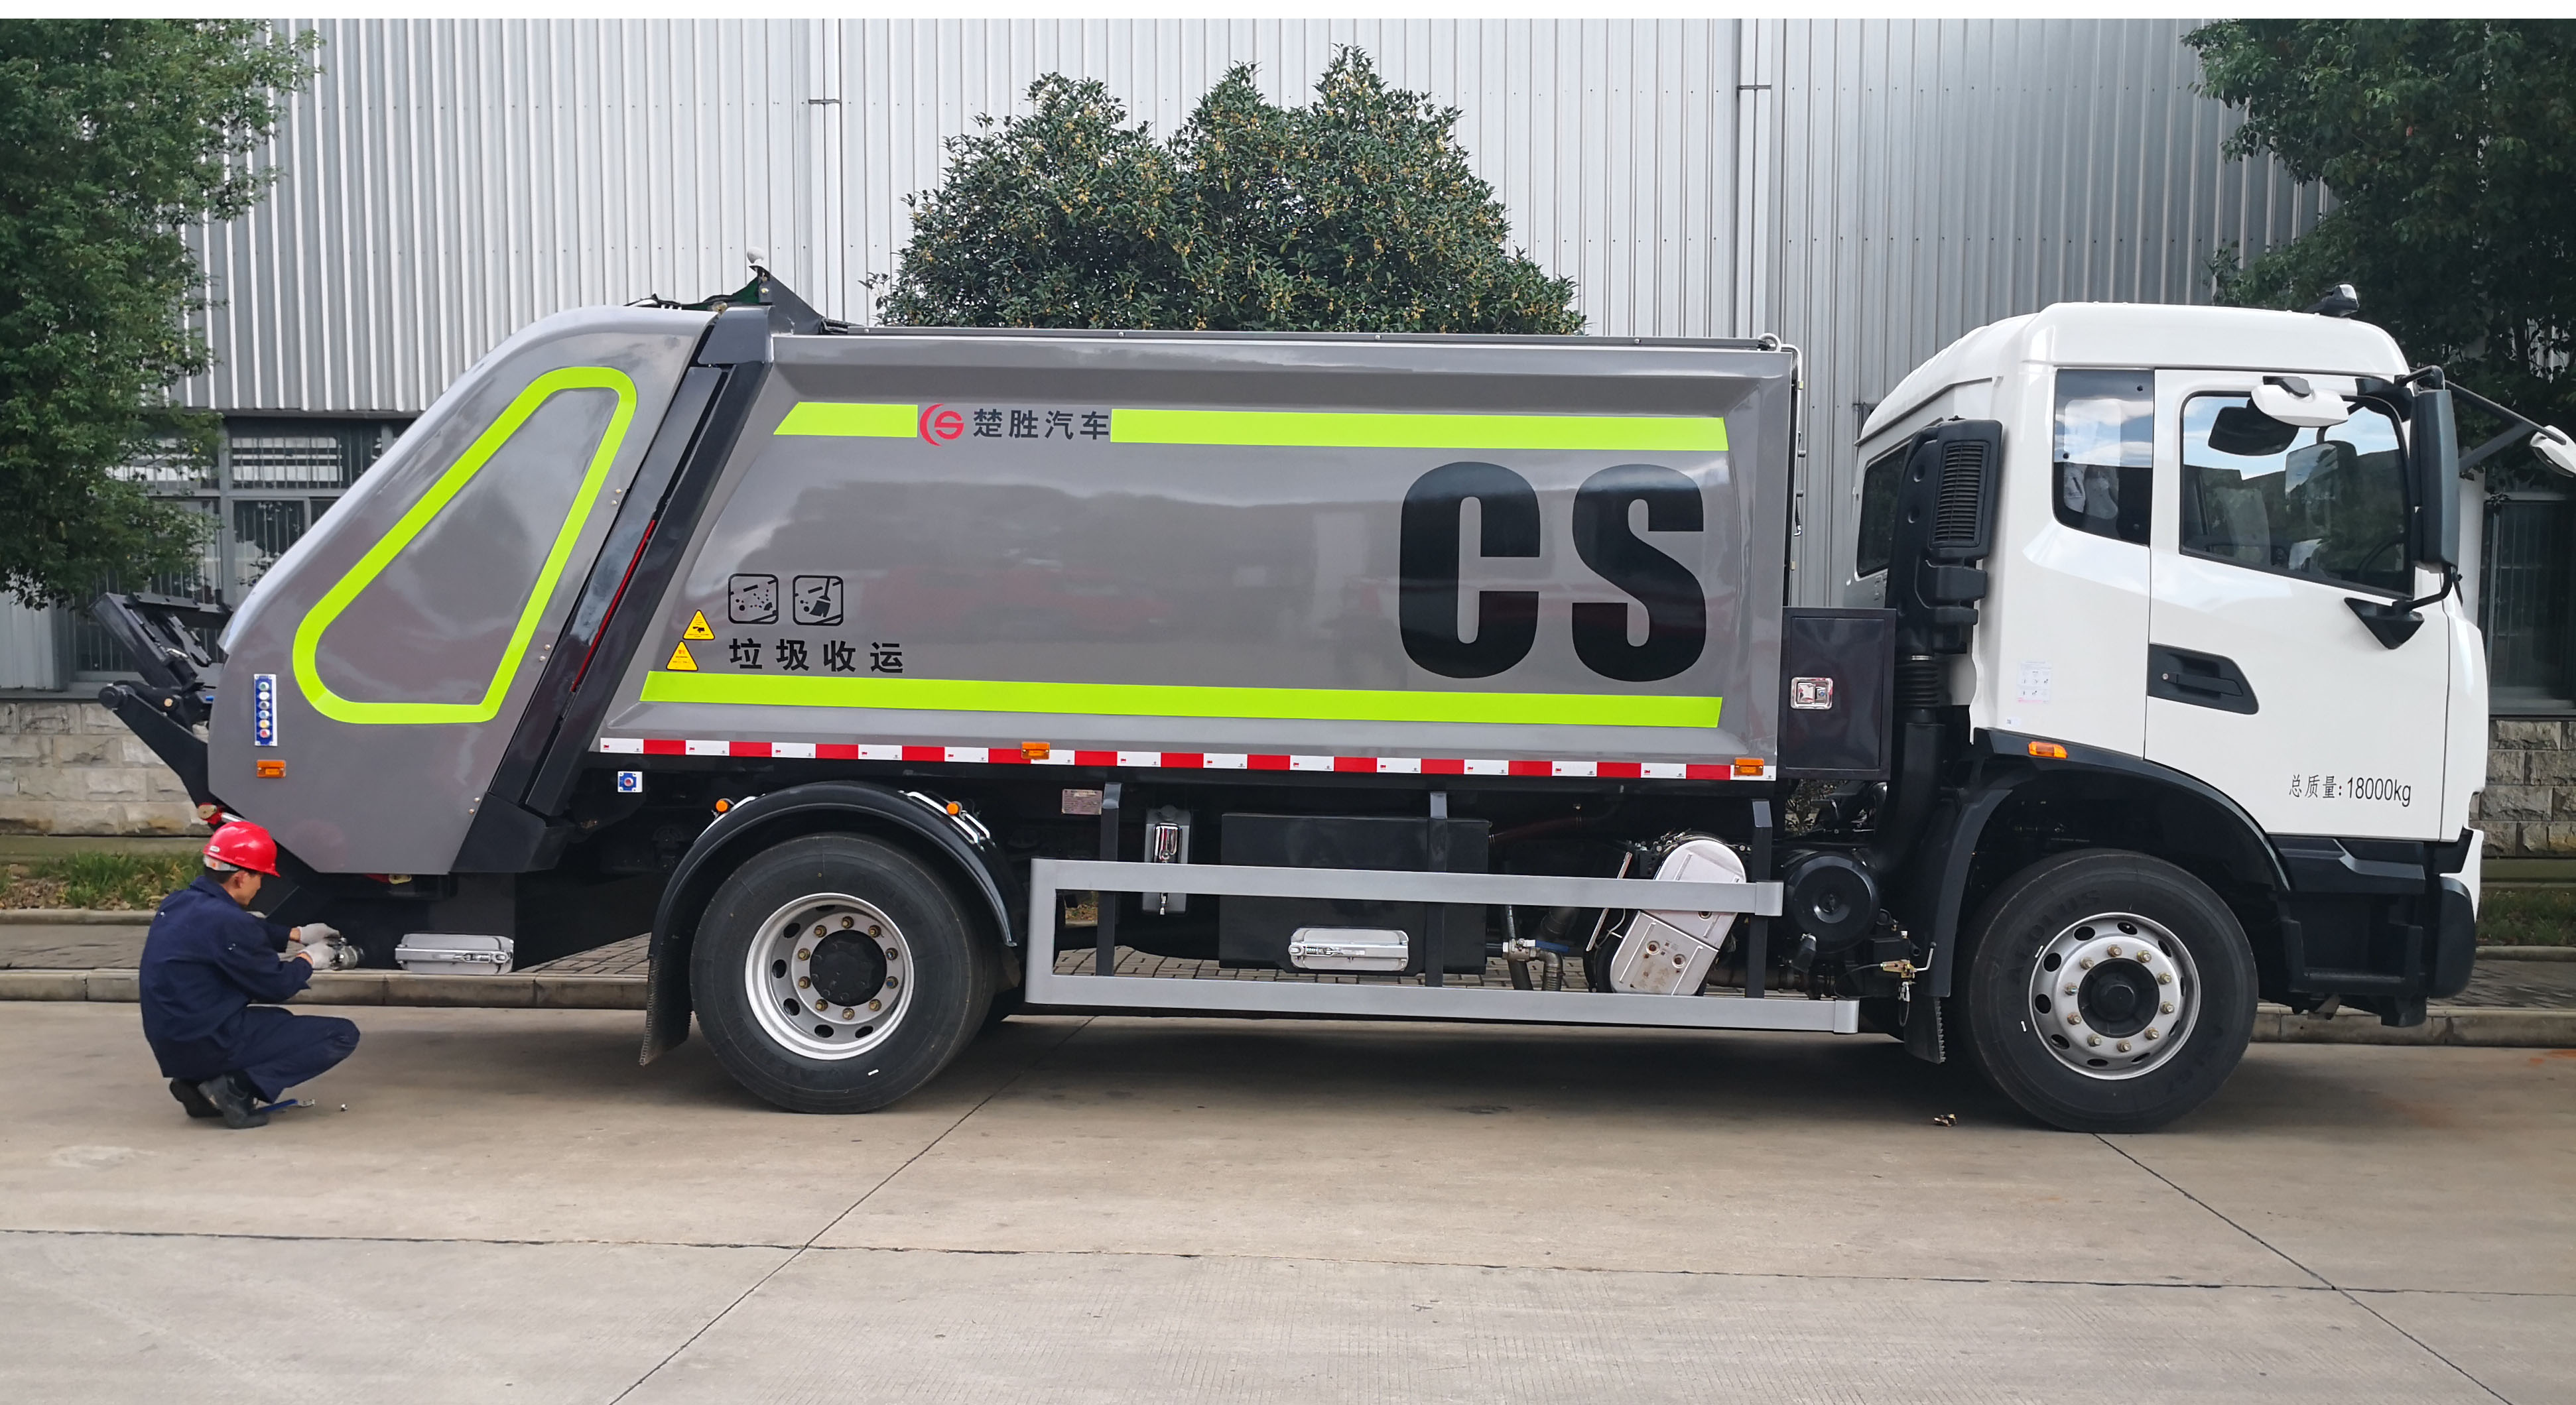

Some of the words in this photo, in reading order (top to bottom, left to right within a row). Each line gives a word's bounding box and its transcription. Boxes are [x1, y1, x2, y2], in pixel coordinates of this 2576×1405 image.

[973, 408, 1110, 440] 楚胜汽车
[1399, 461, 1707, 682] CS
[729, 638, 903, 674] 垃圾收运
